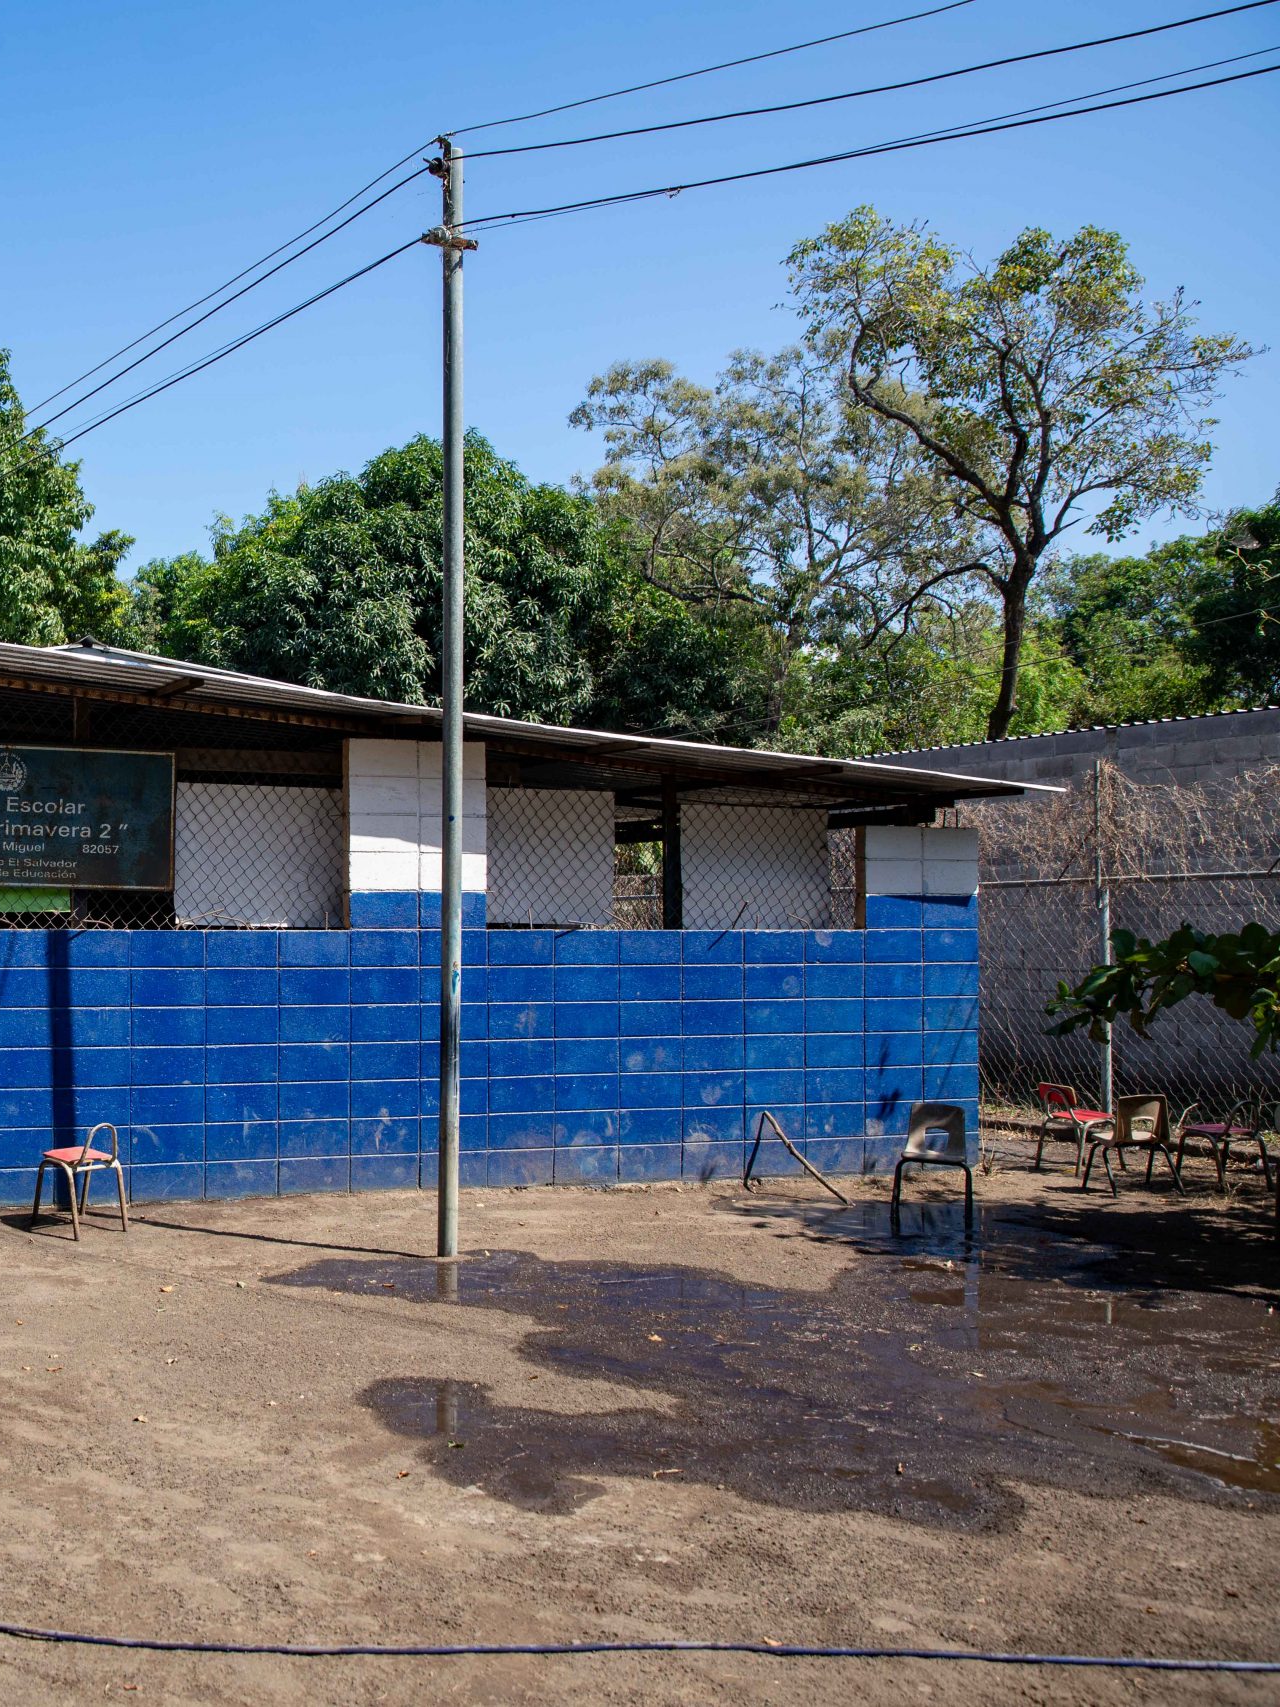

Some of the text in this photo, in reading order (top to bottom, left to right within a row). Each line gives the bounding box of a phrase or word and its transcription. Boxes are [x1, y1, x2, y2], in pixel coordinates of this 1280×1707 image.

[6, 796, 86, 815] Escolar
[2, 841, 45, 854] Miguel
[82, 844, 119, 854] 82057
[8, 857, 20, 867] El
[23, 858, 77, 868] Salvador
[13, 868, 76, 879] Educación
